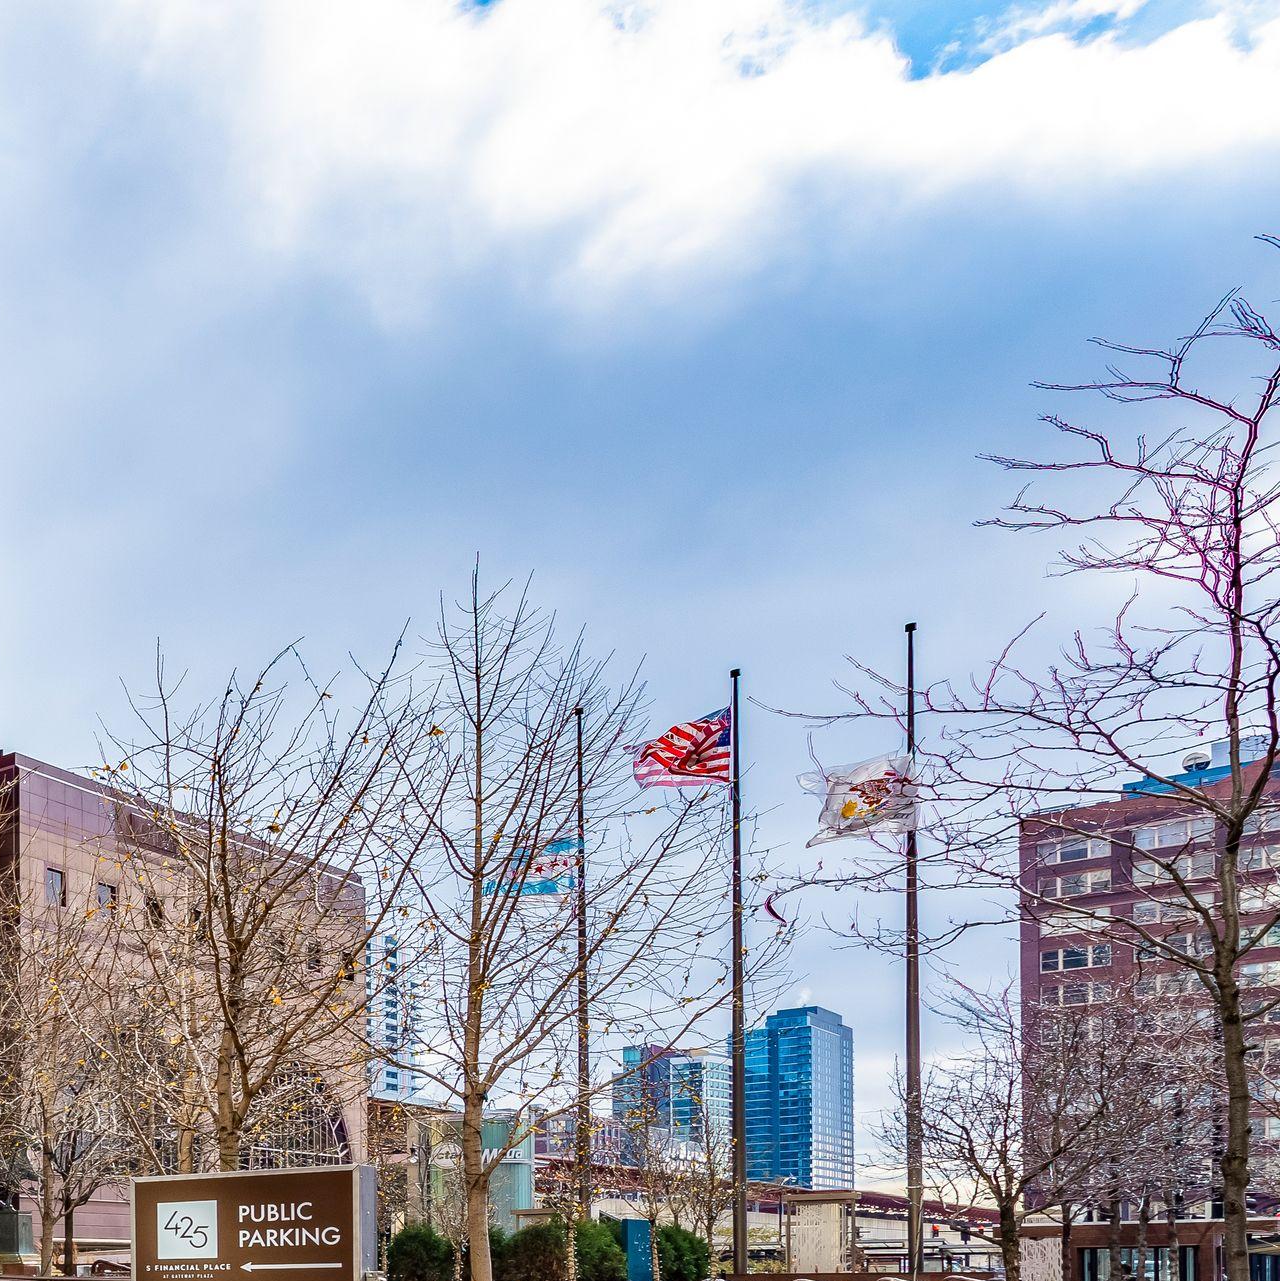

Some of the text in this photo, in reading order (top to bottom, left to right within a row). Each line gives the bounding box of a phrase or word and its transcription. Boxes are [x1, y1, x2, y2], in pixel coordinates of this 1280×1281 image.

[238, 1202, 313, 1223] PUBLIC
[164, 1210, 210, 1249] 425
[238, 1226, 341, 1248] PARKING
[145, 1264, 151, 1272] S
[203, 1263, 232, 1271] PLACE
